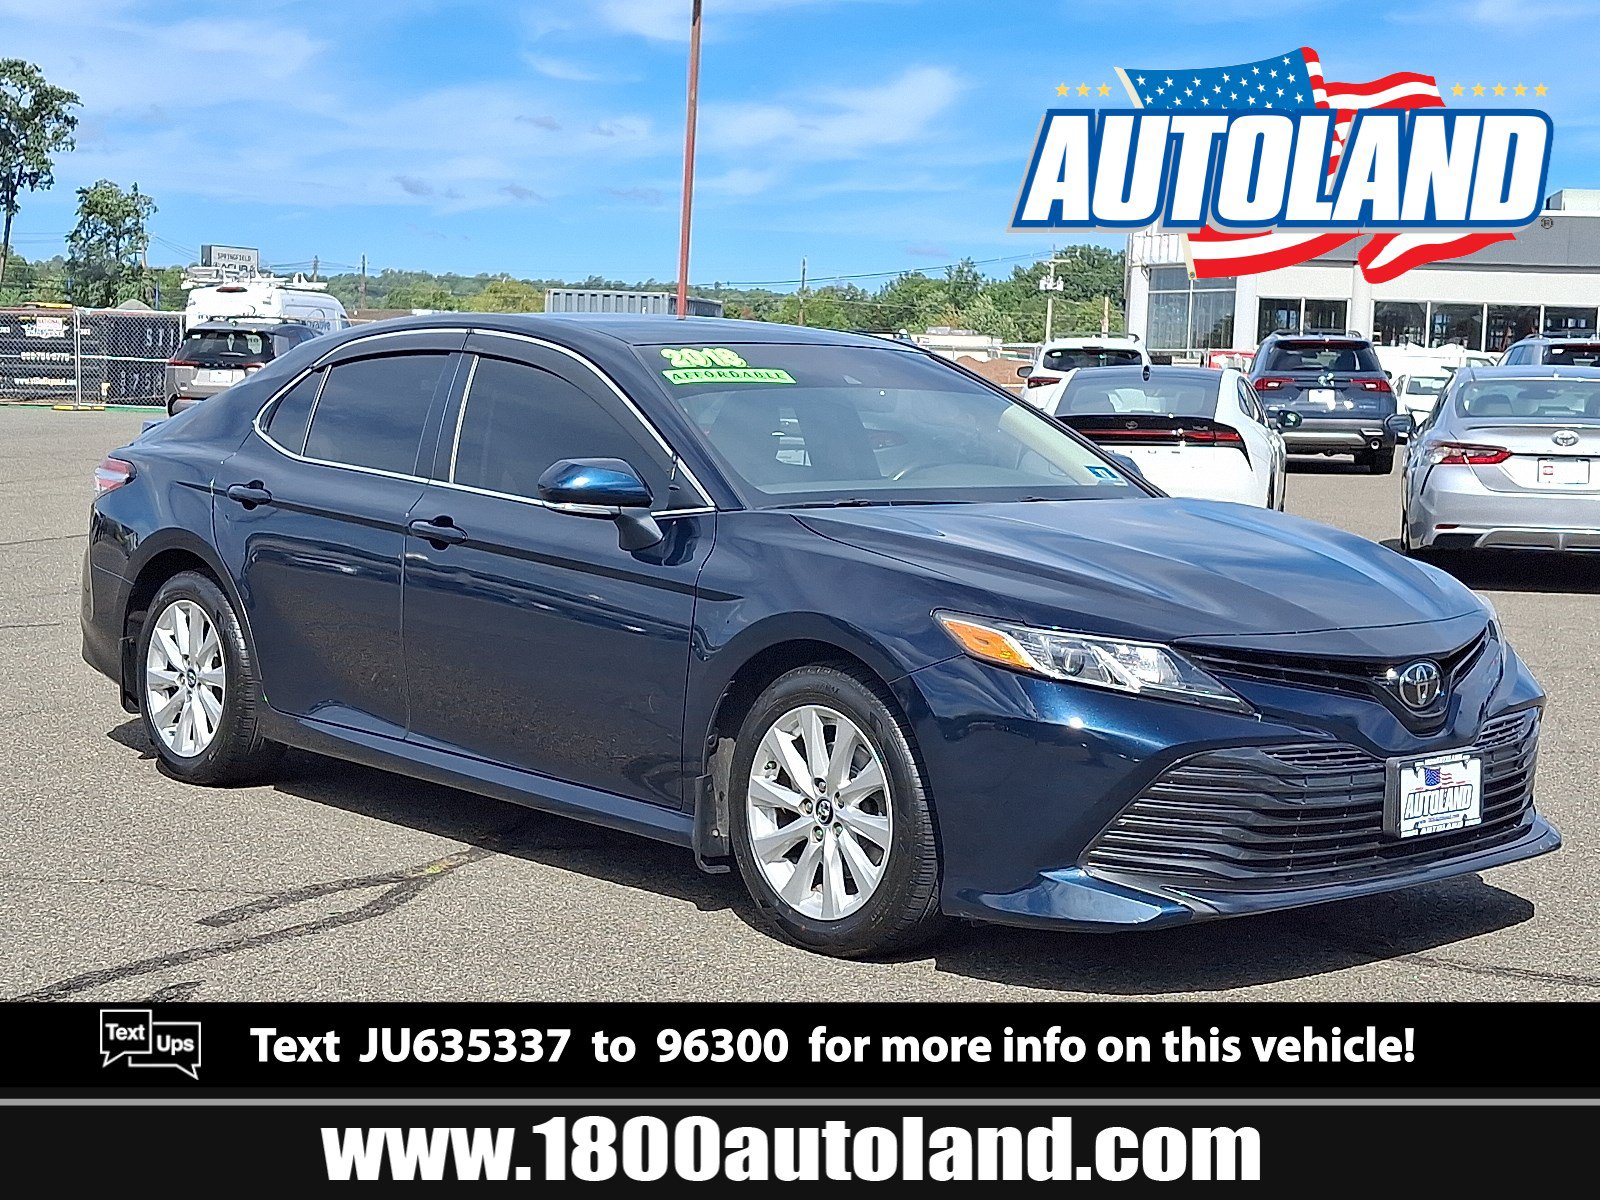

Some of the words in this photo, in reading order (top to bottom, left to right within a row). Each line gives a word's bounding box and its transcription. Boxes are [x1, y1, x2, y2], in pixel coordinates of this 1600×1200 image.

[217, 252, 252, 262] SPRINGFIELD
[660, 347, 748, 368] 2018
[671, 369, 790, 382] AFFORDABLE
[1404, 784, 1473, 820] AUTOLAND
